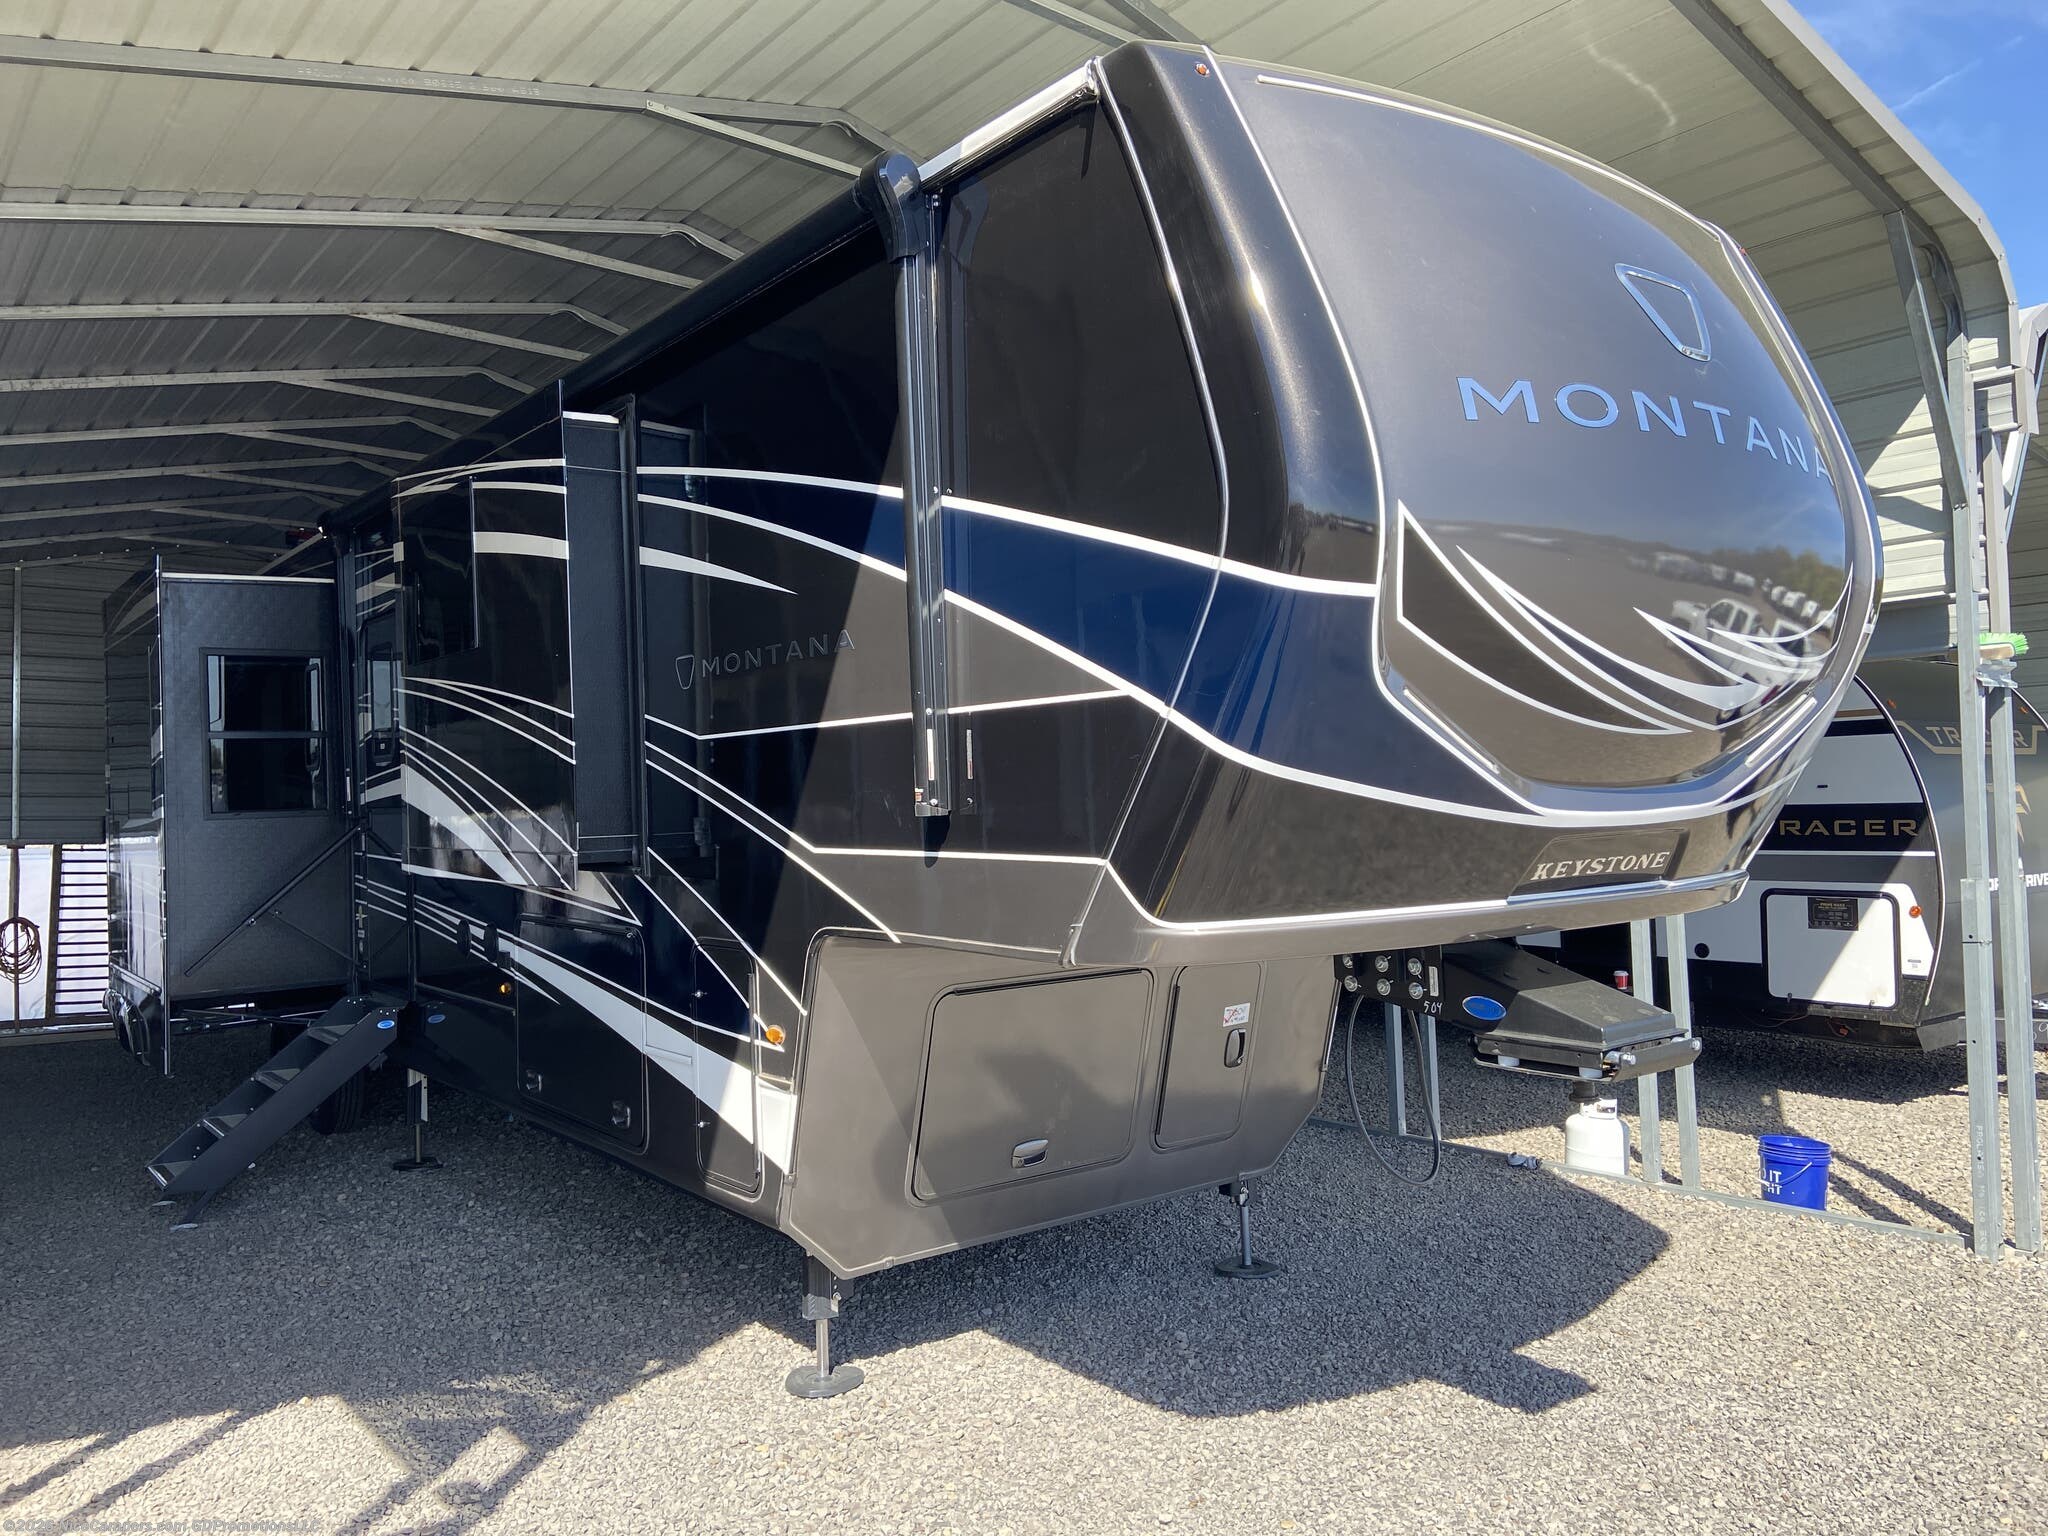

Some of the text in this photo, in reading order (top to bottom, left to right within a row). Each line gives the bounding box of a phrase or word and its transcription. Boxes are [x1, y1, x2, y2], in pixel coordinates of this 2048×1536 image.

[1456, 376, 1834, 487] MONTANA
[701, 629, 855, 678] MONTANA
[1530, 851, 1670, 881] KEYSTONE
